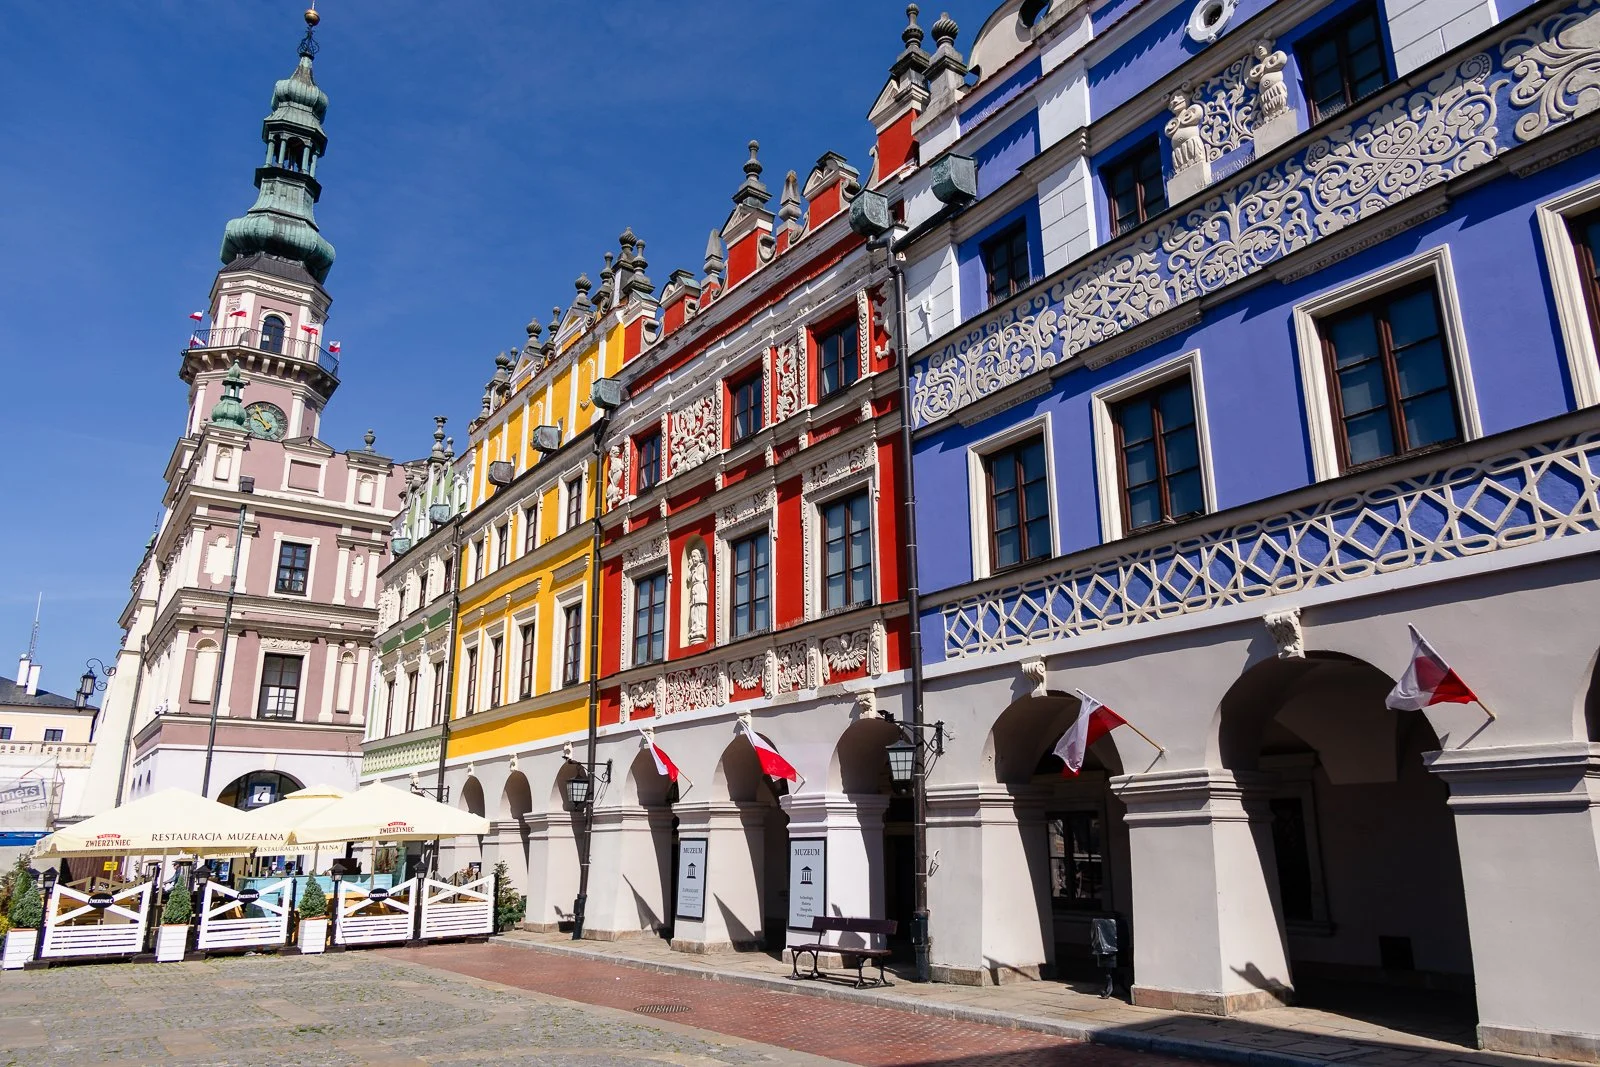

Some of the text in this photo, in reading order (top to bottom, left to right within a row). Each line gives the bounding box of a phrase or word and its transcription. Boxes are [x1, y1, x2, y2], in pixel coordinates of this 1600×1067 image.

[152, 832, 285, 841] RESTAURACJA MUZEALNA
[85, 839, 131, 848] ZWIERZYNIEC
